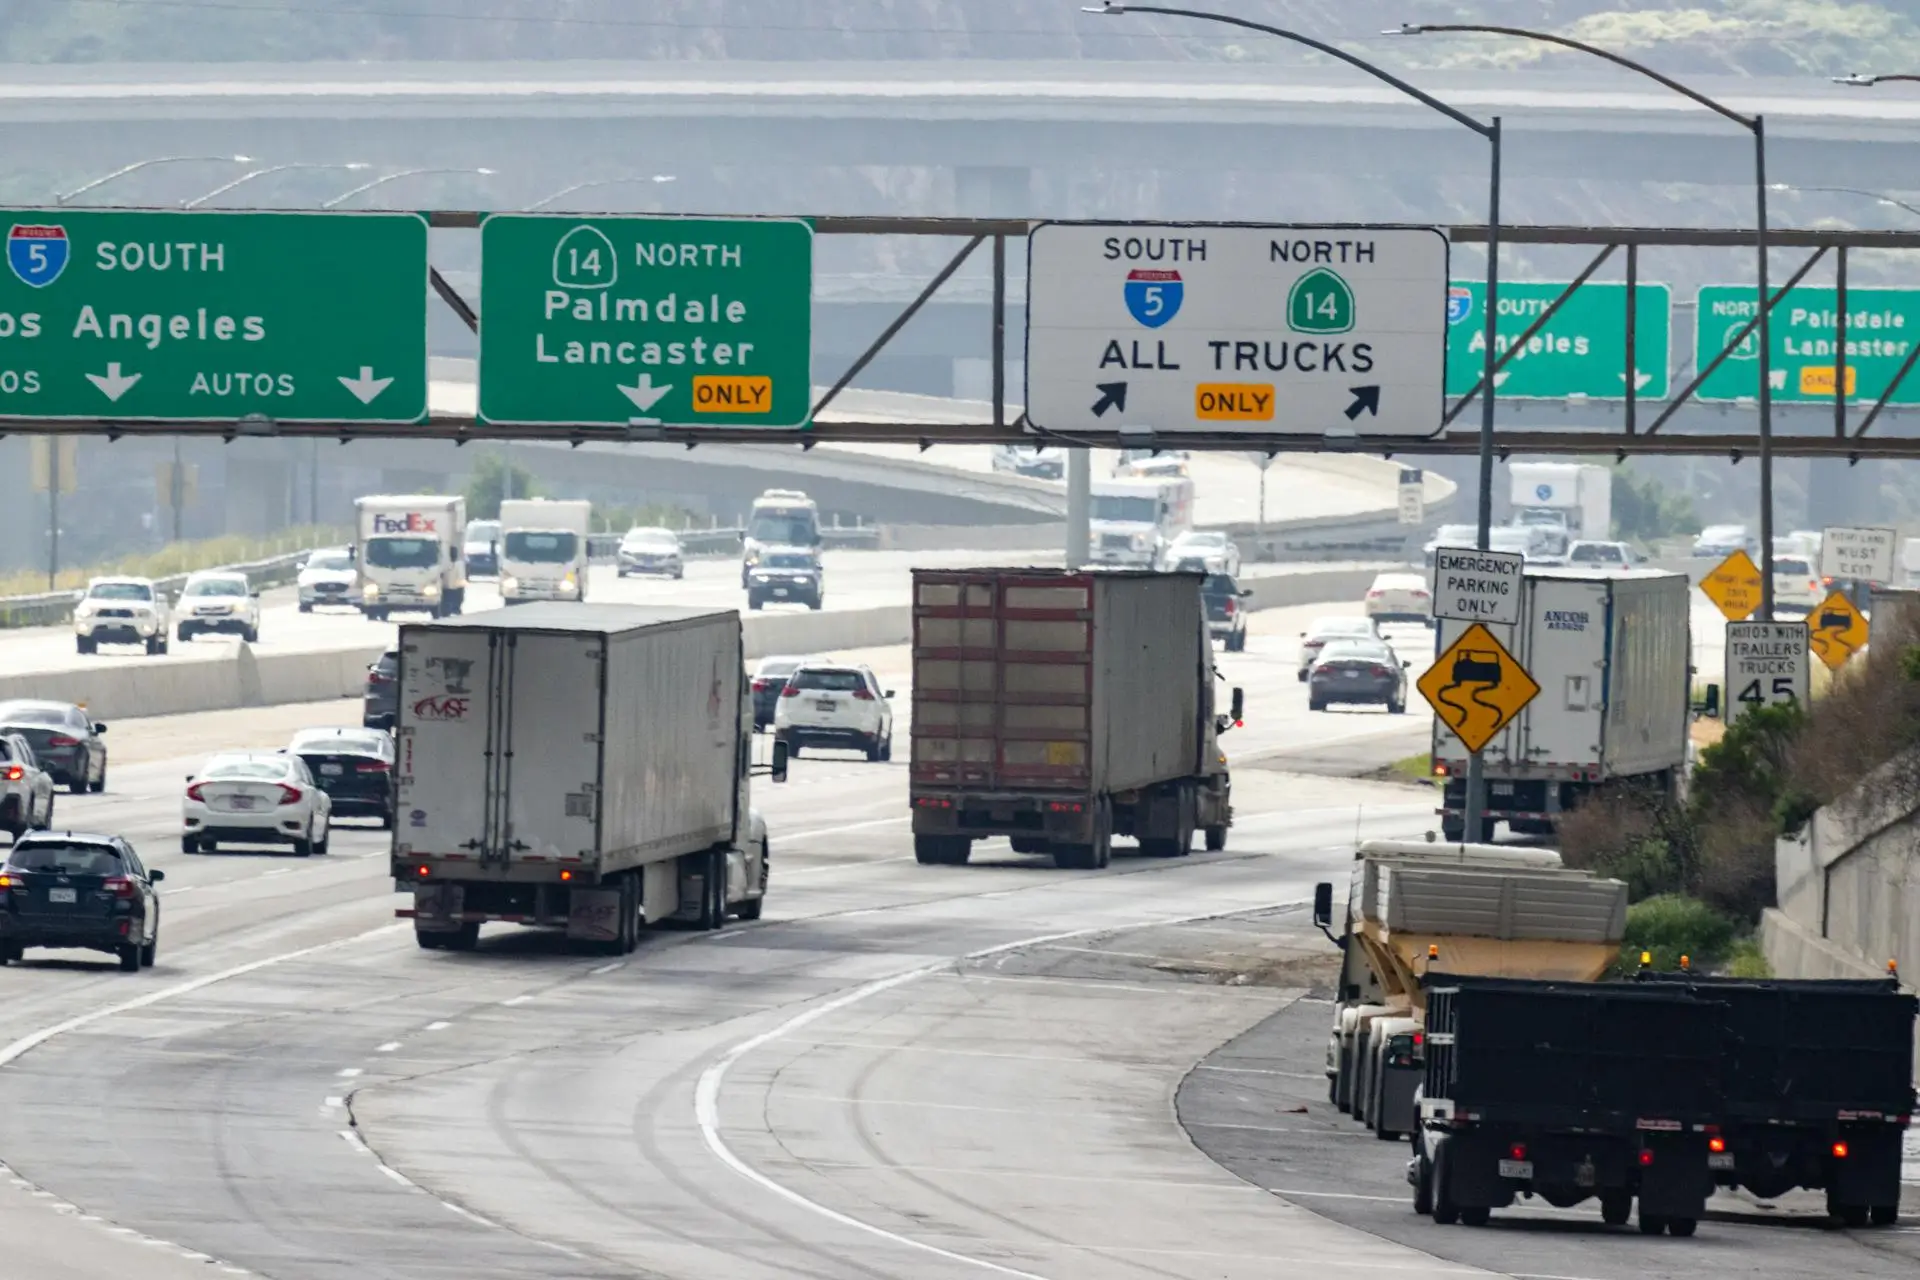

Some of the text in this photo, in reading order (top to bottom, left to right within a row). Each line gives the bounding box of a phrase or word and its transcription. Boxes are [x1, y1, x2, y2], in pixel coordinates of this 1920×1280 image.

[29, 242, 225, 274] 5 SOUTH
[569, 242, 742, 277] 14 NORTH
[1103, 237, 1207, 261] SOUTH
[1269, 240, 1375, 264] NORTH
[545, 290, 747, 323] Palmdale
[1144, 286, 1164, 317] 5
[1304, 292, 1339, 321] 14
[1712, 300, 1773, 317] NORT
[73, 305, 267, 350] Angeles
[536, 333, 754, 366] Lancaster
[1099, 339, 1375, 373] ALL TRUCKS
[189, 372, 296, 397] AUTOS
[697, 383, 767, 404] ONLY
[1199, 392, 1271, 413] ONLY
[373, 512, 437, 534] FedEx
[1439, 555, 1520, 576] EMERGENCY
[1447, 576, 1510, 596] PARKING
[1457, 598, 1499, 615] ONLY
[1730, 626, 1805, 639] AUTOS WITH
[1732, 642, 1802, 656] TRAILERS
[1738, 661, 1797, 674] TRUCKS
[1737, 677, 1797, 704] 45
